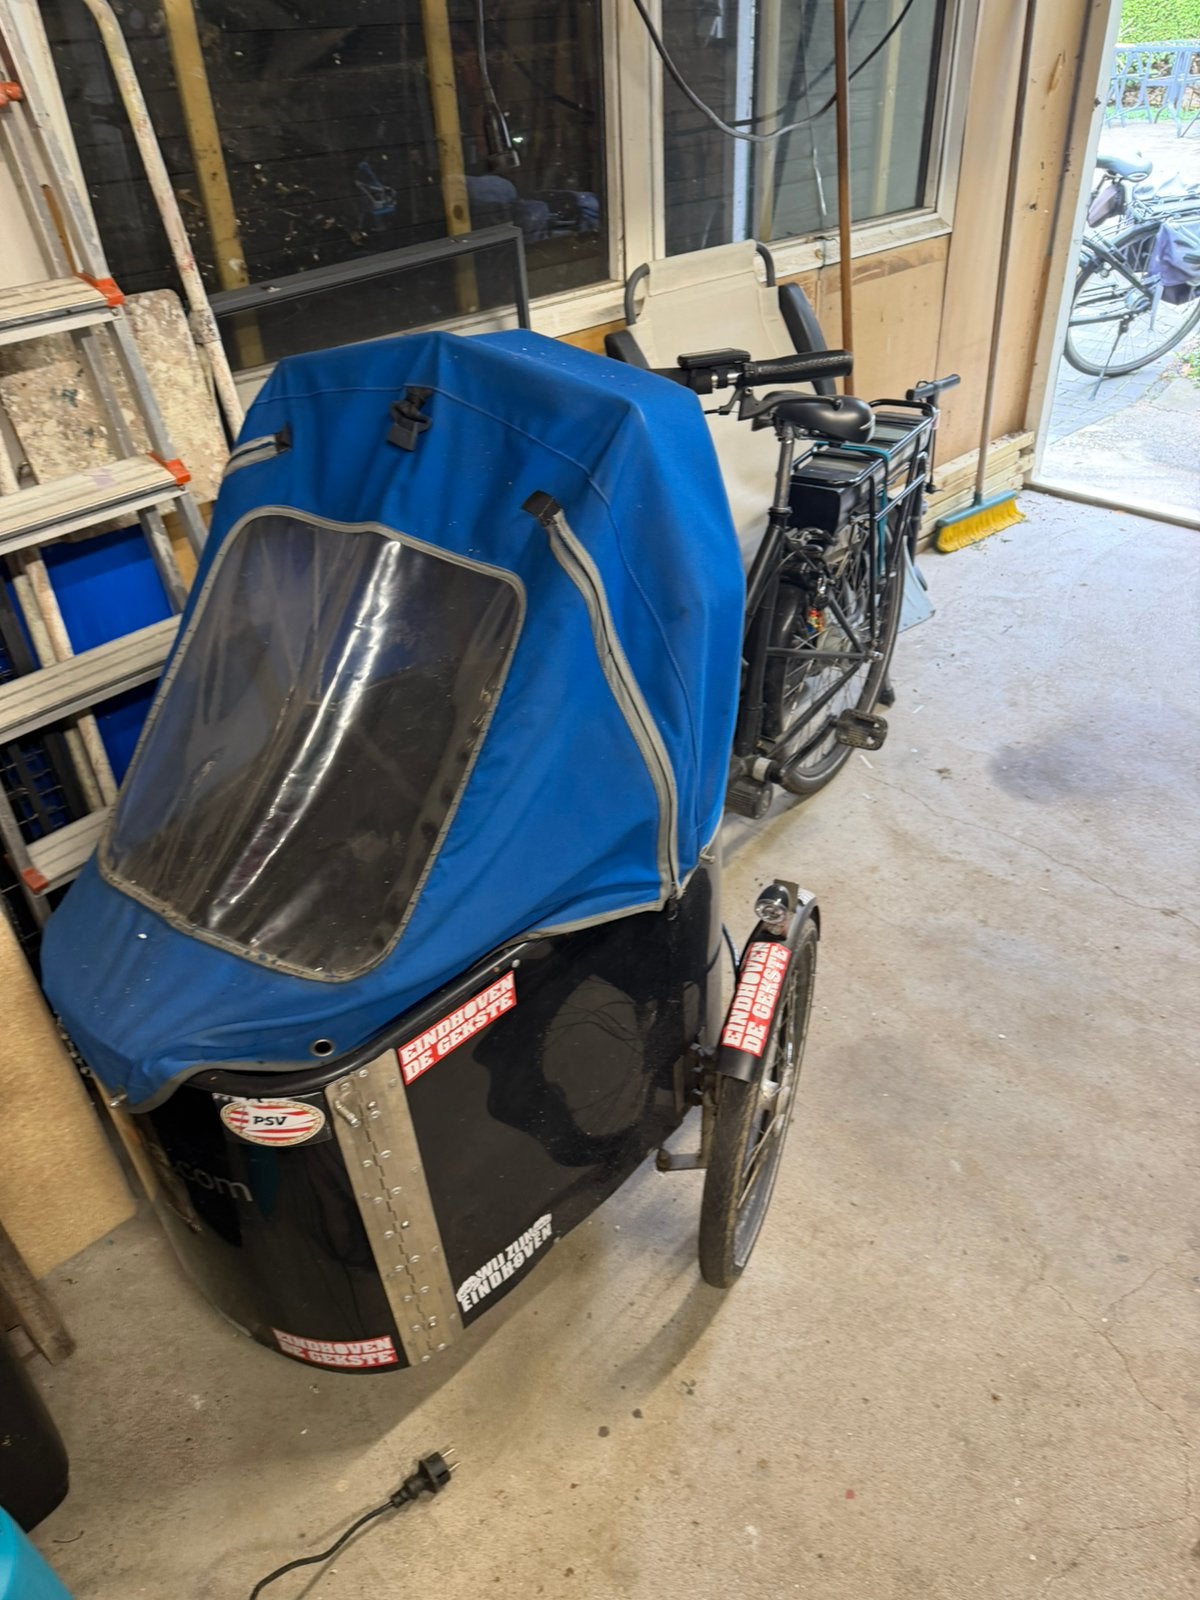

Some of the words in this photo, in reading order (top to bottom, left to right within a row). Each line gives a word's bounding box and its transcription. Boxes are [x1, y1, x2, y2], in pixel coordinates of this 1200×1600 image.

[400, 973, 514, 1065] EINDHOVEN
[722, 943, 770, 1047] EINDHOVEN
[752, 945, 789, 1020] GEKSTE
[403, 1048, 435, 1082] DE
[437, 990, 514, 1056] GEKSTE
[741, 1021, 767, 1054] DE
[253, 1115, 287, 1126] PSV
[461, 1223, 552, 1313] EINDHOVEN
[307, 1349, 396, 1367] GEKSTE
